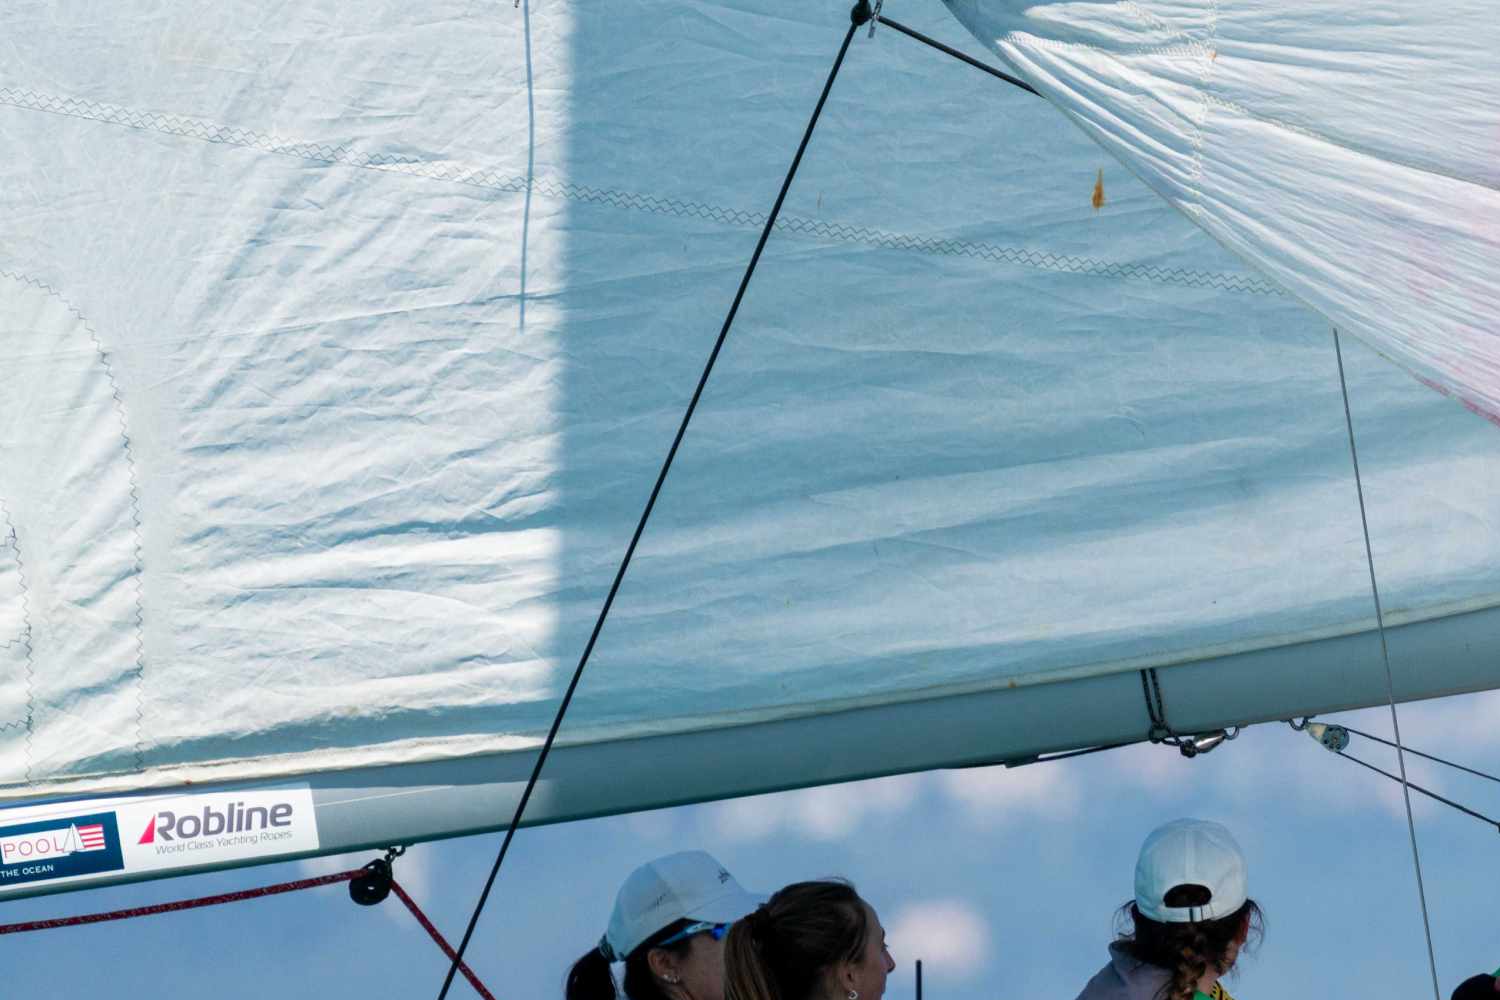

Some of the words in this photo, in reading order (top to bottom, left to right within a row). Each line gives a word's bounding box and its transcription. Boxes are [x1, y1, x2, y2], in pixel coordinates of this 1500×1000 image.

[157, 801, 293, 841] Robline
[156, 842, 185, 855] World
[187, 838, 215, 850] Class
[217, 832, 258, 847] Yachting
[260, 829, 293, 842] Ropes
[0, 869, 20, 879] THE
[22, 864, 54, 878] OCEAN
